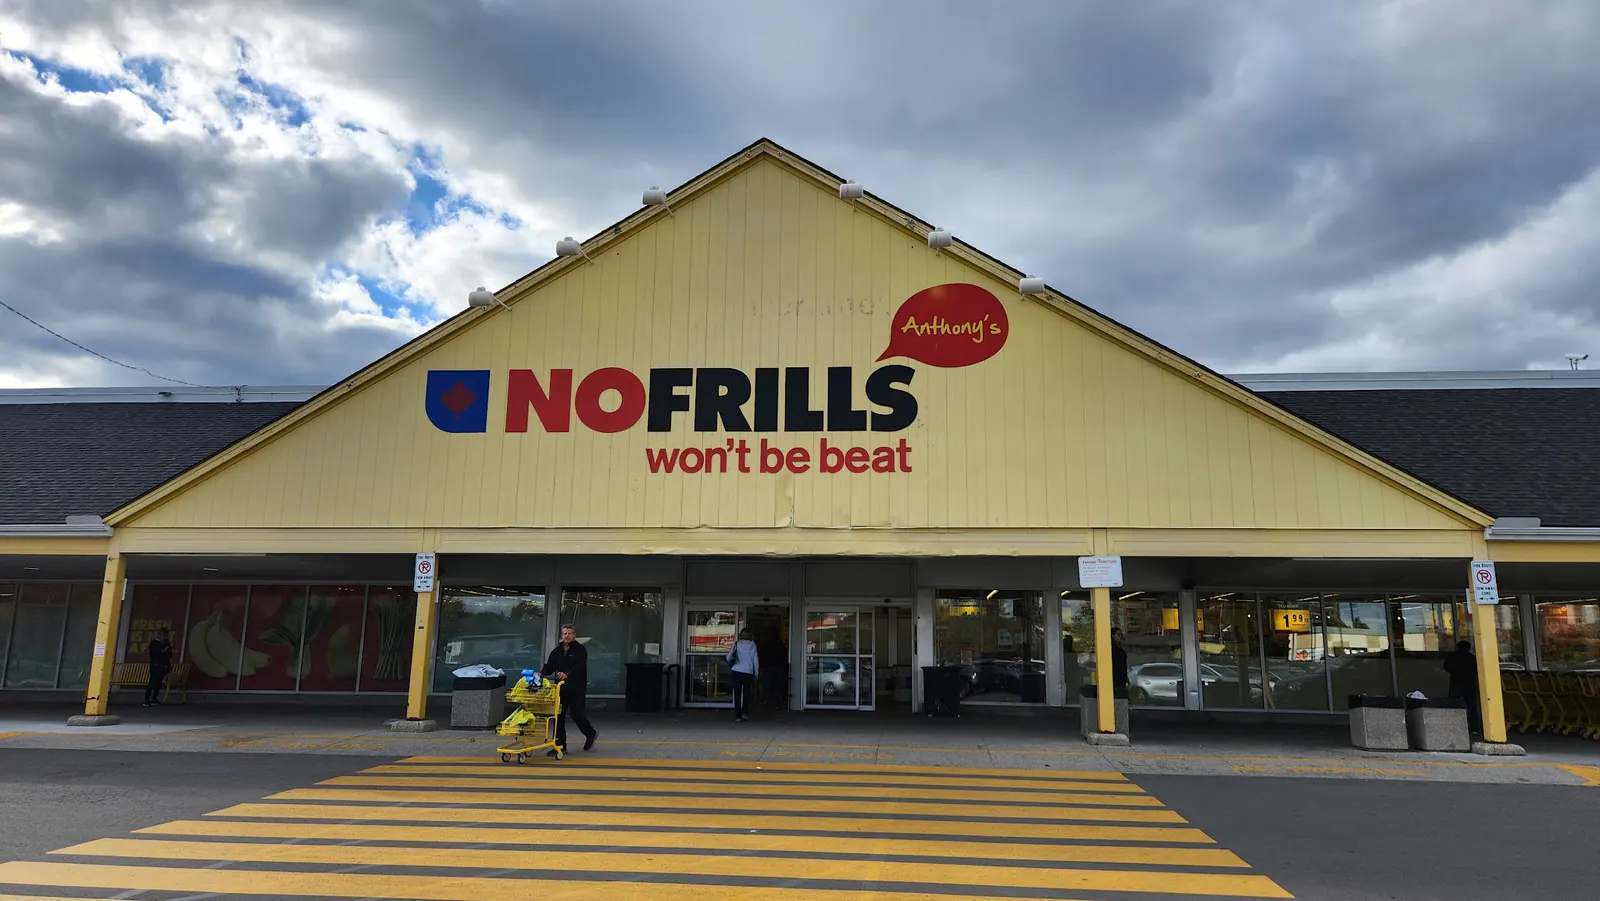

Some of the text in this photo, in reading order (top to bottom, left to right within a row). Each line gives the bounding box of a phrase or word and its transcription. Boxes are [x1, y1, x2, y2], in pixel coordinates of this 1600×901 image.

[900, 314, 1002, 343] Anthony's
[646, 438, 912, 474] won't be beat
[132, 618, 172, 630] FRESH
